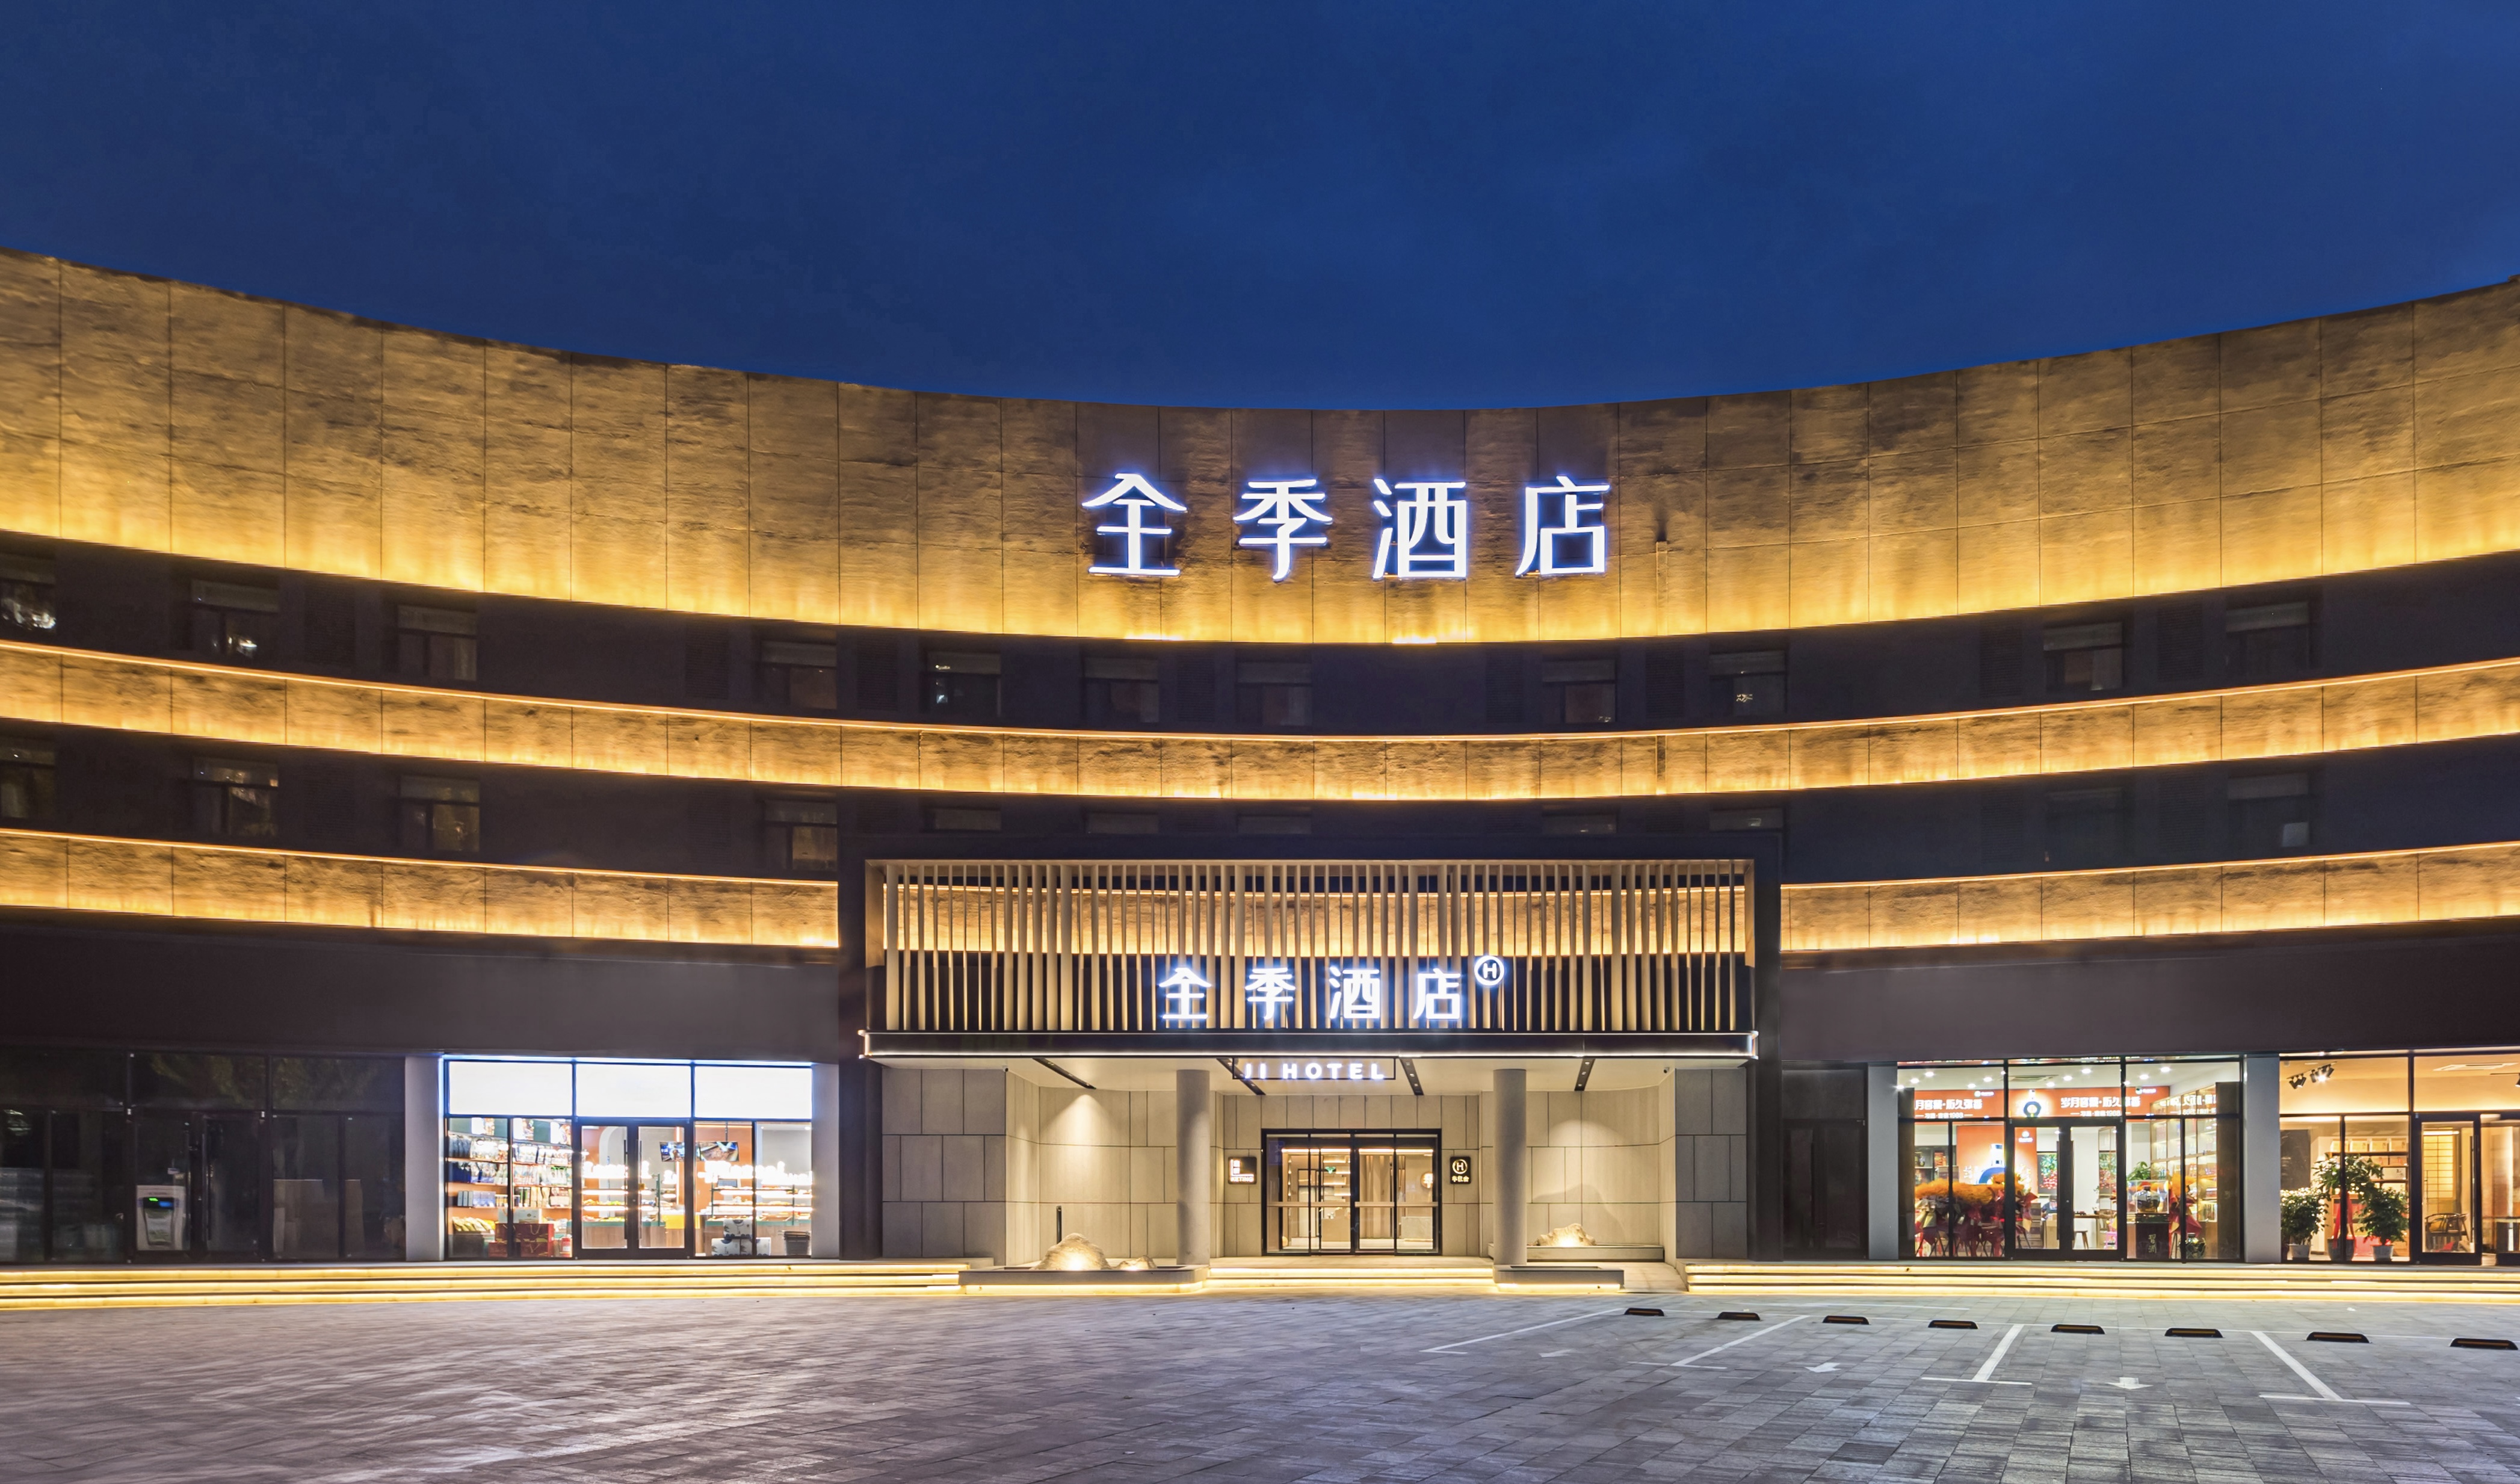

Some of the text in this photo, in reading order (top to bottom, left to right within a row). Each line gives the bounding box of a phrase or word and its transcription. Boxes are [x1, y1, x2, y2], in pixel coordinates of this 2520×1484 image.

[1081, 472, 1611, 581] 全季酒店
[1159, 966, 1462, 1021] 全季酒店
[1244, 1062, 1385, 1080] JI HOTEL
